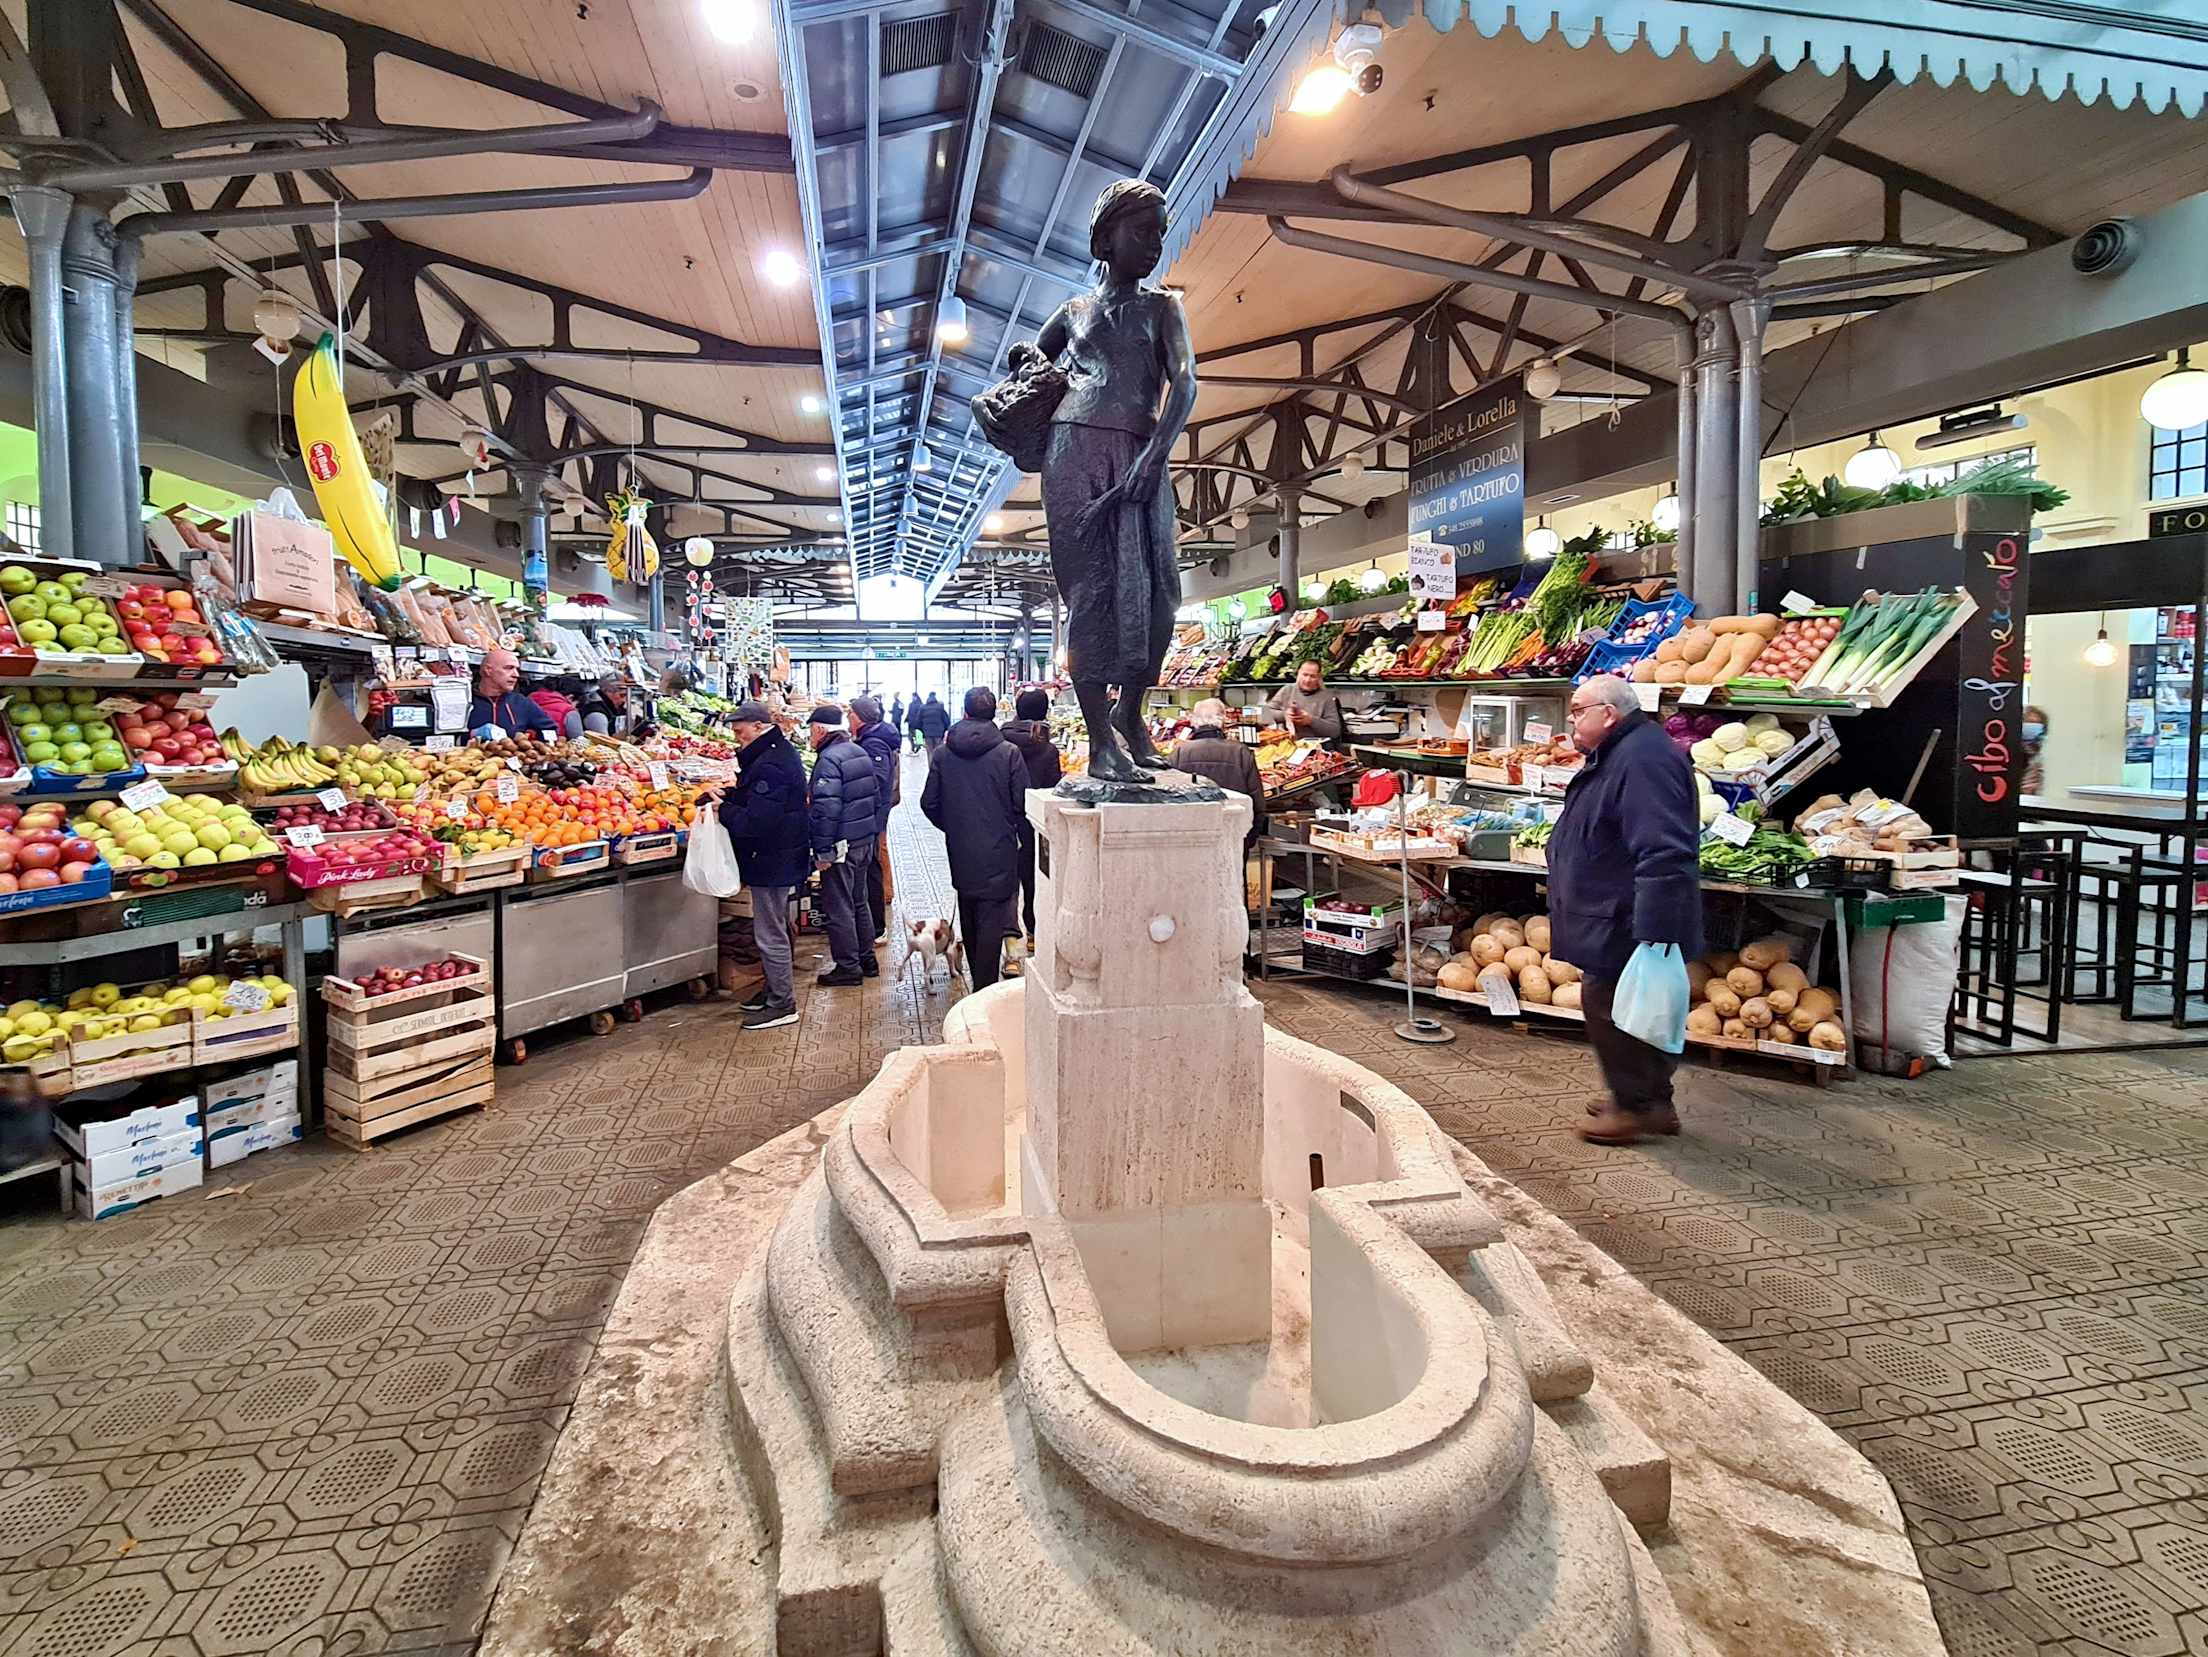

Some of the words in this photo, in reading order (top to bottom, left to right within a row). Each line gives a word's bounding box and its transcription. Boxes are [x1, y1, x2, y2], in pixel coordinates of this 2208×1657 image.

[1413, 424, 1455, 457] Daniele
[1455, 423, 1465, 437] &
[1467, 396, 1517, 432] Lorella
[1410, 471, 1446, 497] FRUTTA
[1459, 442, 1519, 478] VERDURA
[1409, 496, 1447, 524] FUNGHI
[1459, 473, 1520, 508] TARTUFO
[1472, 538, 1485, 556] 80
[317, 871, 349, 885] Pink
[350, 867, 377, 881] Lady
